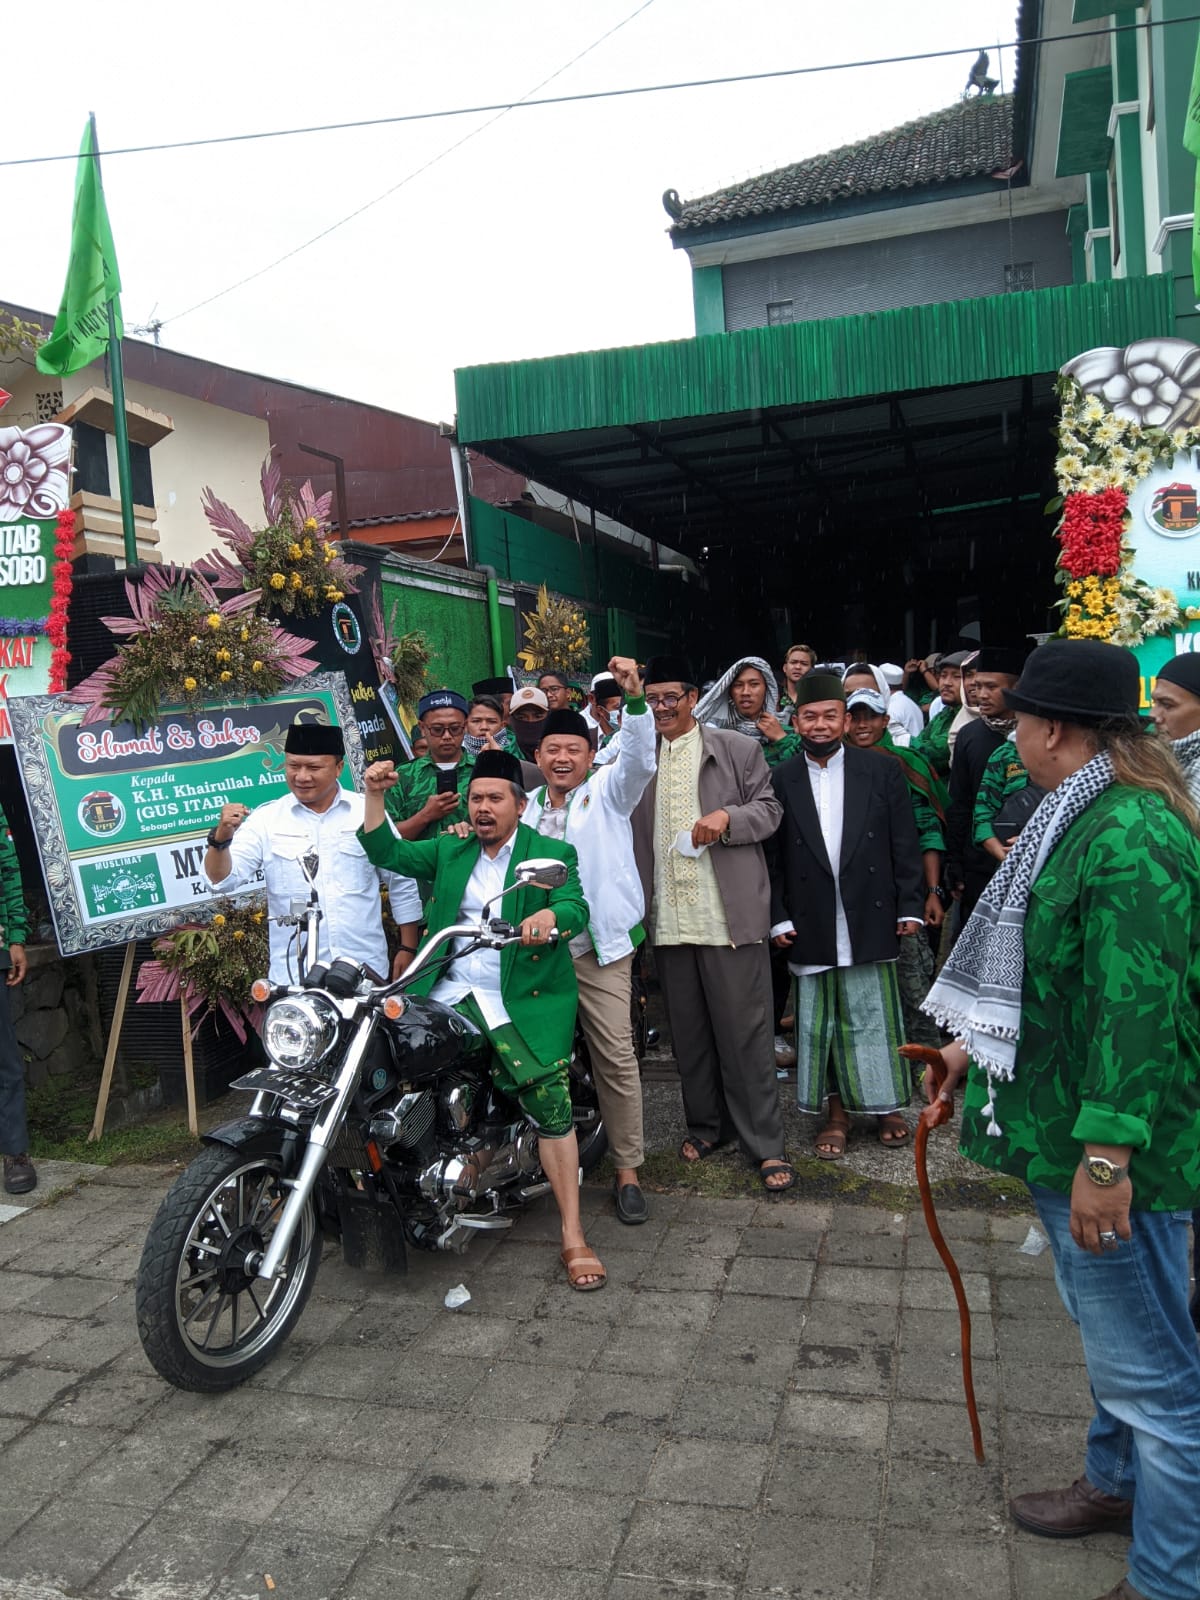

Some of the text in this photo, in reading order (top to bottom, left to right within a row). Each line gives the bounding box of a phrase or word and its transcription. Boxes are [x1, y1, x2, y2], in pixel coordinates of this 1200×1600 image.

[77, 717, 260, 763] Selamat & Sukses
[131, 772, 175, 788] Kepada
[132, 787, 169, 804] K.H.
[173, 776, 254, 798] Khairullah
[136, 795, 230, 823] (GUS ITAB)
[95, 822, 116, 832] PPP
[140, 820, 176, 832] Sebagai
[178, 817, 202, 827] Ketua
[95, 856, 142, 871] MUSLIMAT
[150, 893, 159, 903] U
[96, 904, 106, 914] N
[312, 1084, 335, 1097] TA
